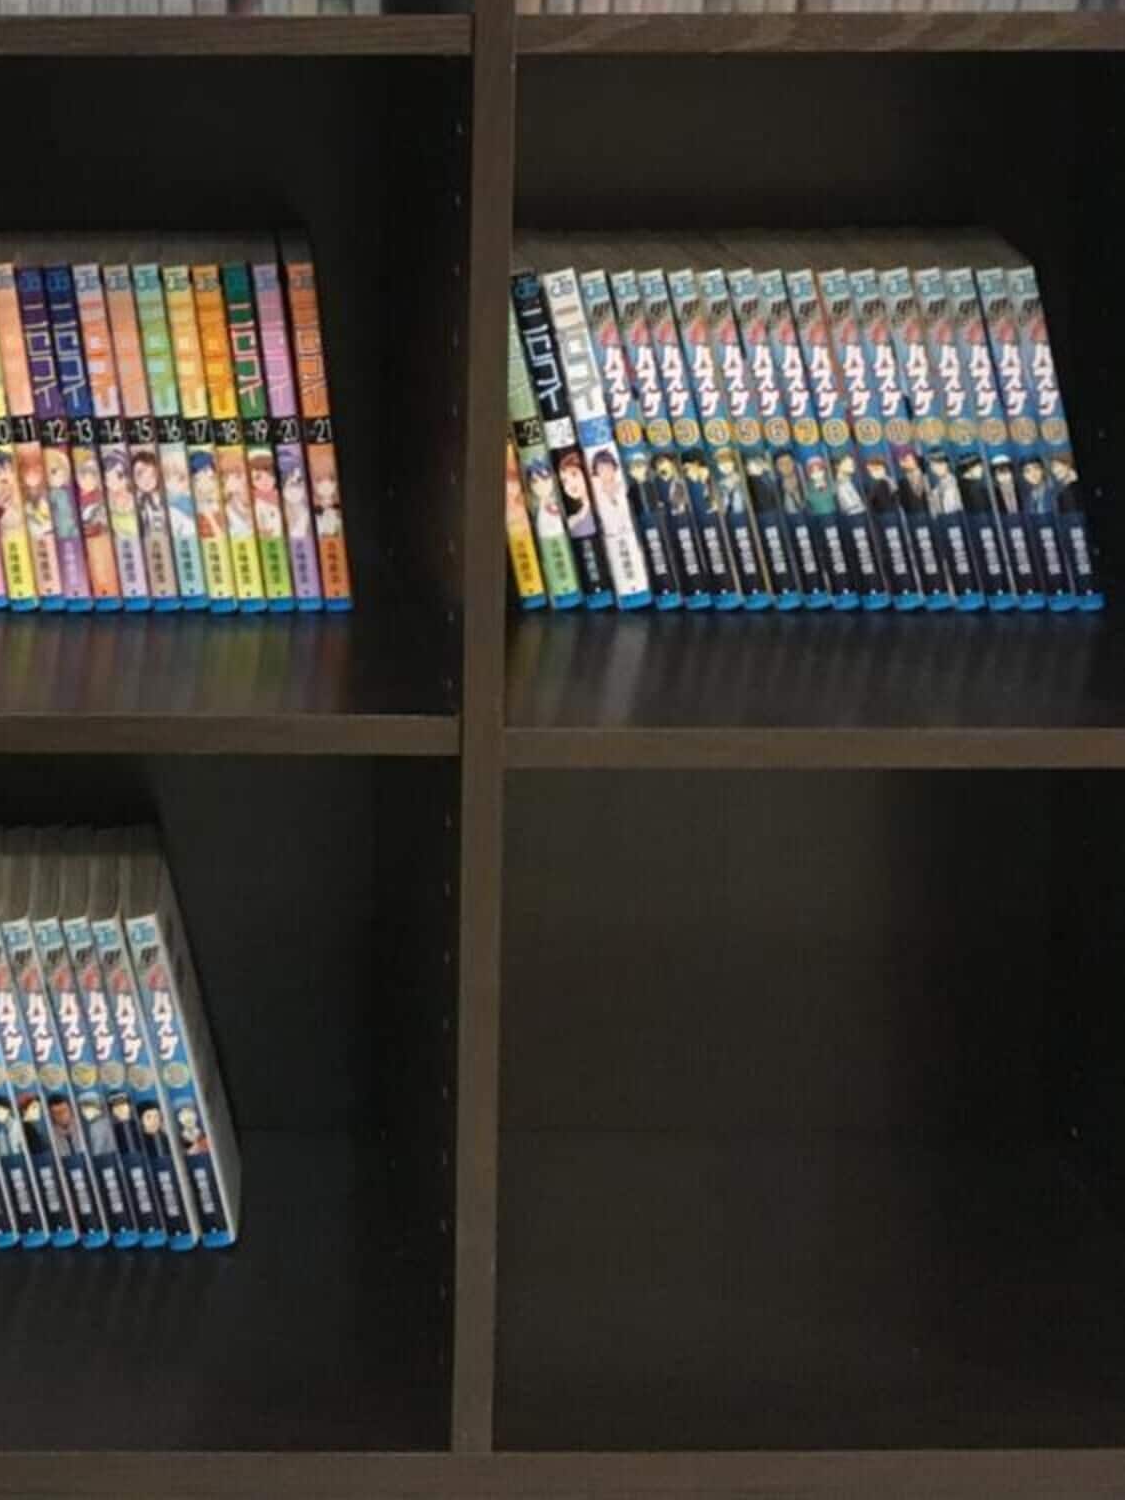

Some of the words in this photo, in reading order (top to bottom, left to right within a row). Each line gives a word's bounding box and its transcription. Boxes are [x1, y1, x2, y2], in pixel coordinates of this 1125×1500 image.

[23, 303, 57, 409] ニセコイ
[51, 303, 85, 408] ニセコイ
[228, 303, 263, 409] ニセコイ
[522, 308, 562, 412] ニセコイ
